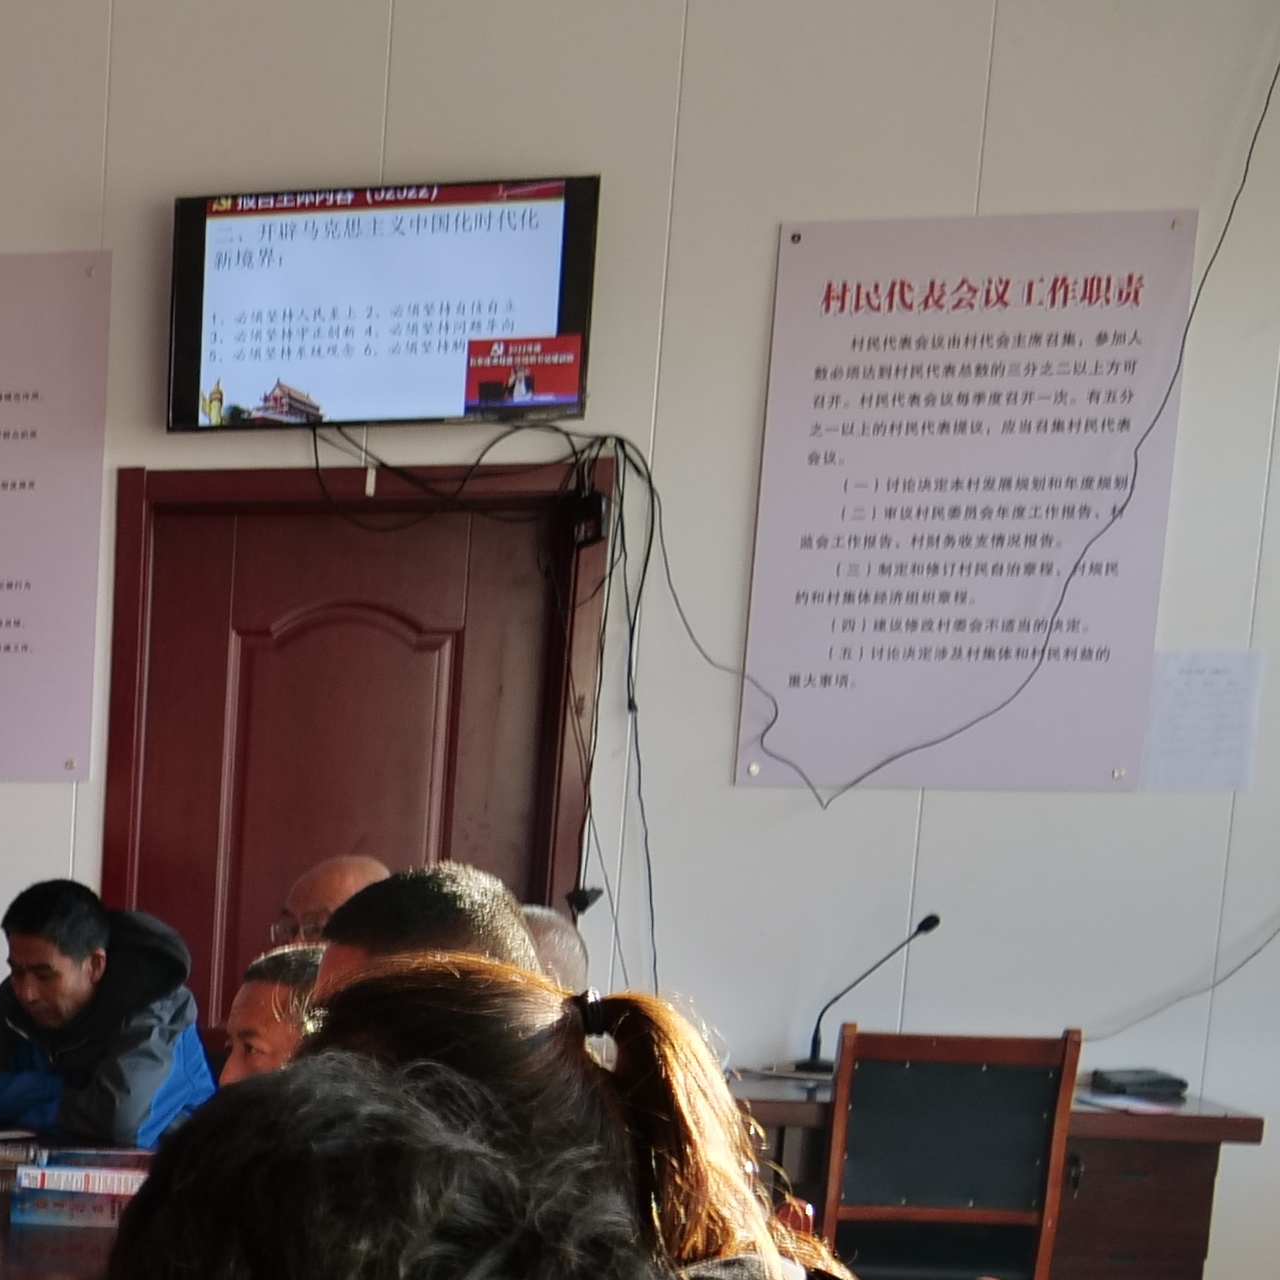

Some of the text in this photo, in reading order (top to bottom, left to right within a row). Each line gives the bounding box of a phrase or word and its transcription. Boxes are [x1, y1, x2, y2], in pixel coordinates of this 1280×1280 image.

[819, 272, 1146, 316] 村民代表会议工作职责
[806, 449, 846, 467] 会议。
[786, 671, 857, 690] 重大事项。
